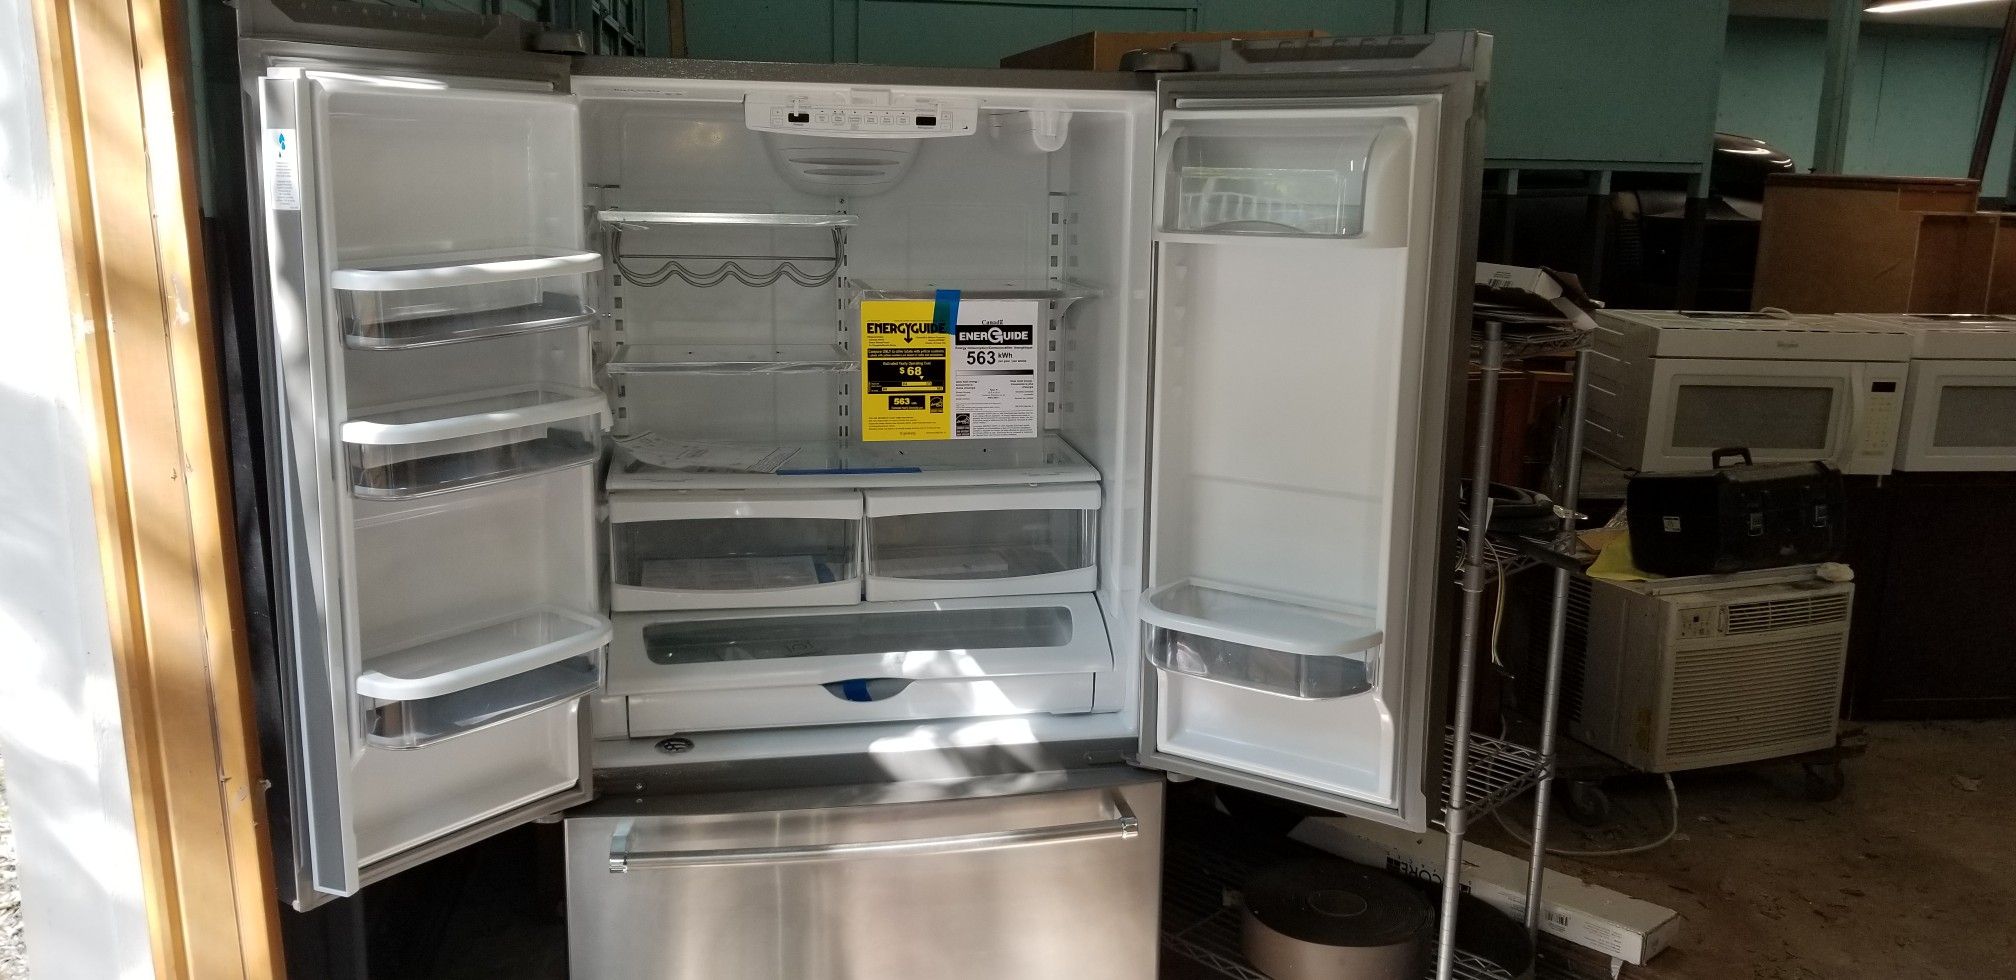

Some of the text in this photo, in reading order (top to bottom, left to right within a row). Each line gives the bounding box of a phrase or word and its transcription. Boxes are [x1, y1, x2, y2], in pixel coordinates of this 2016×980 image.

[866, 322, 946, 335] ENERGYGUIDE
[959, 326, 1029, 344] ENERGUIDE
[966, 350, 996, 365] 563
[899, 366, 923, 376] $ 68
[893, 397, 910, 406] 563
